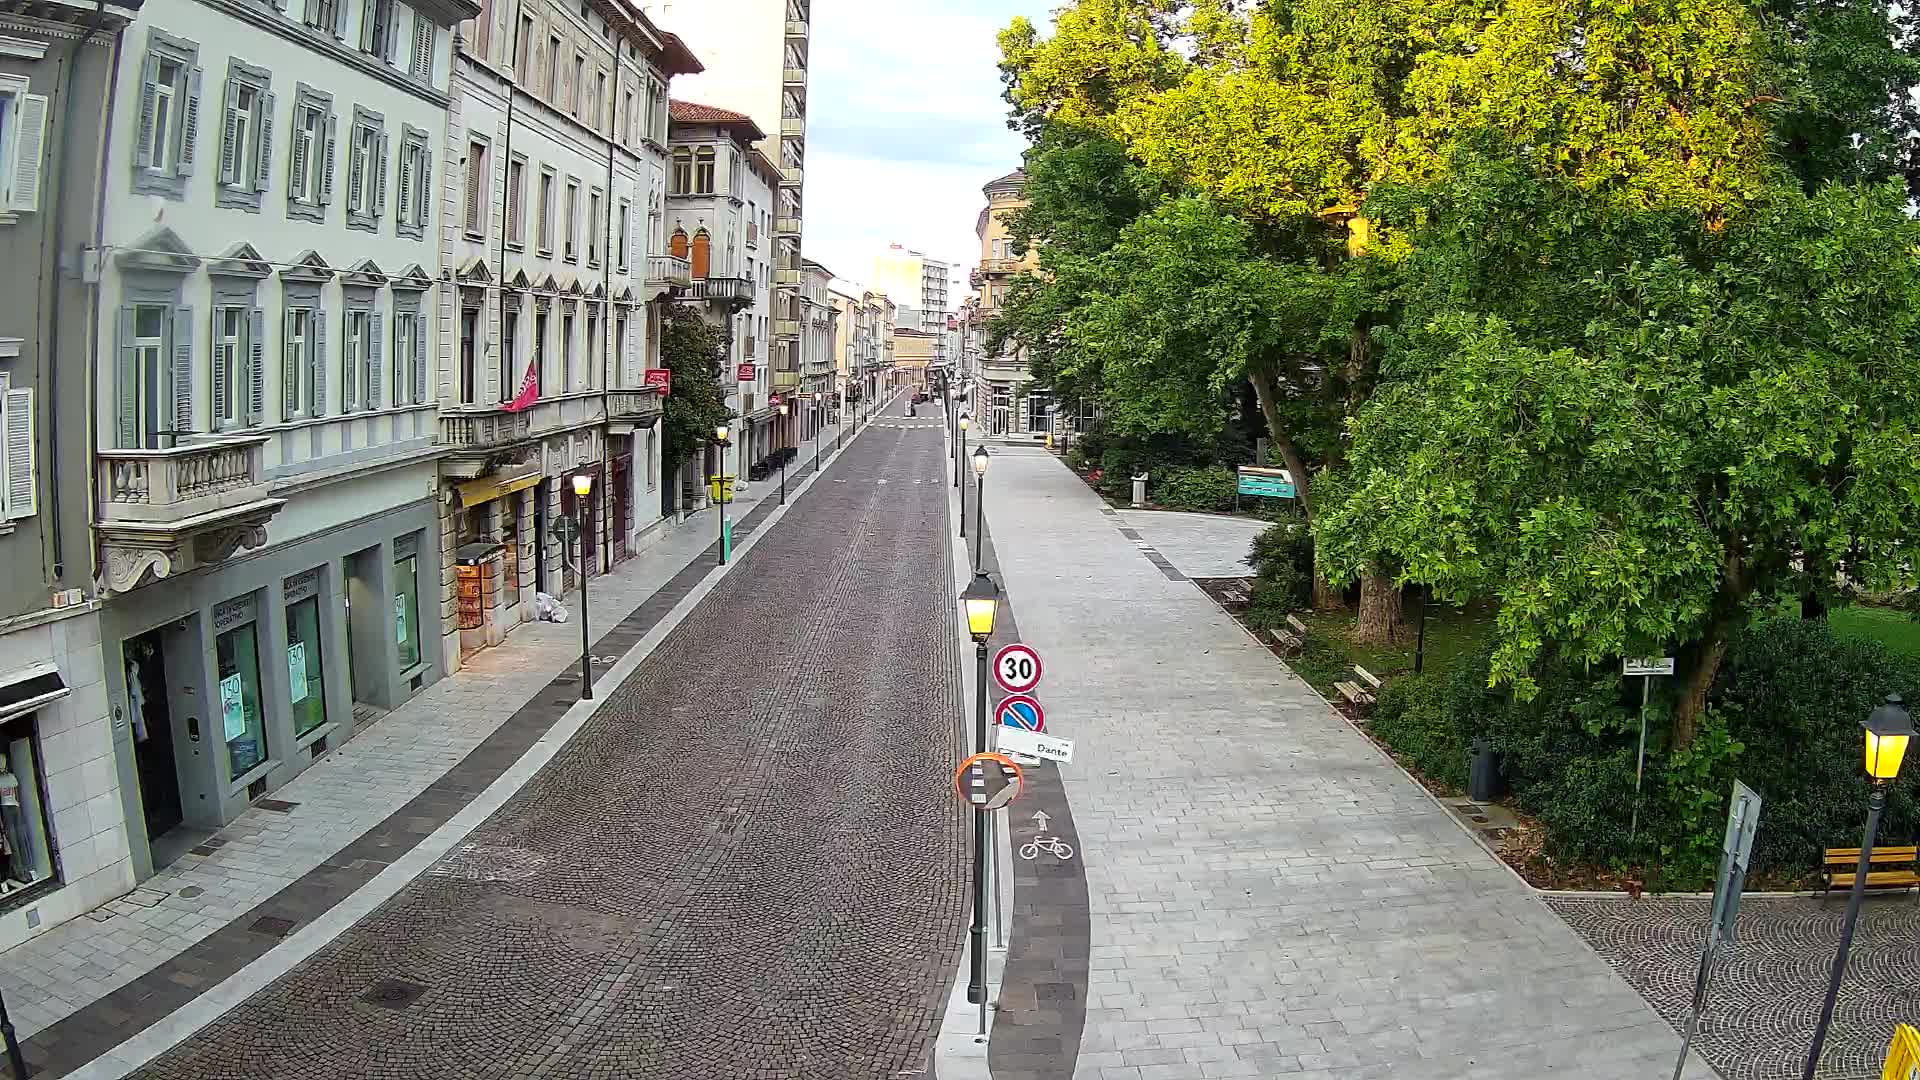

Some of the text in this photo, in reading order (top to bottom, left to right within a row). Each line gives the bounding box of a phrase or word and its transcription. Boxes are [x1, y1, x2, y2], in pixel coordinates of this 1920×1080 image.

[1005, 658, 1031, 679] 30
[221, 678, 239, 699] 130
[1037, 743, 1067, 756] Dante
